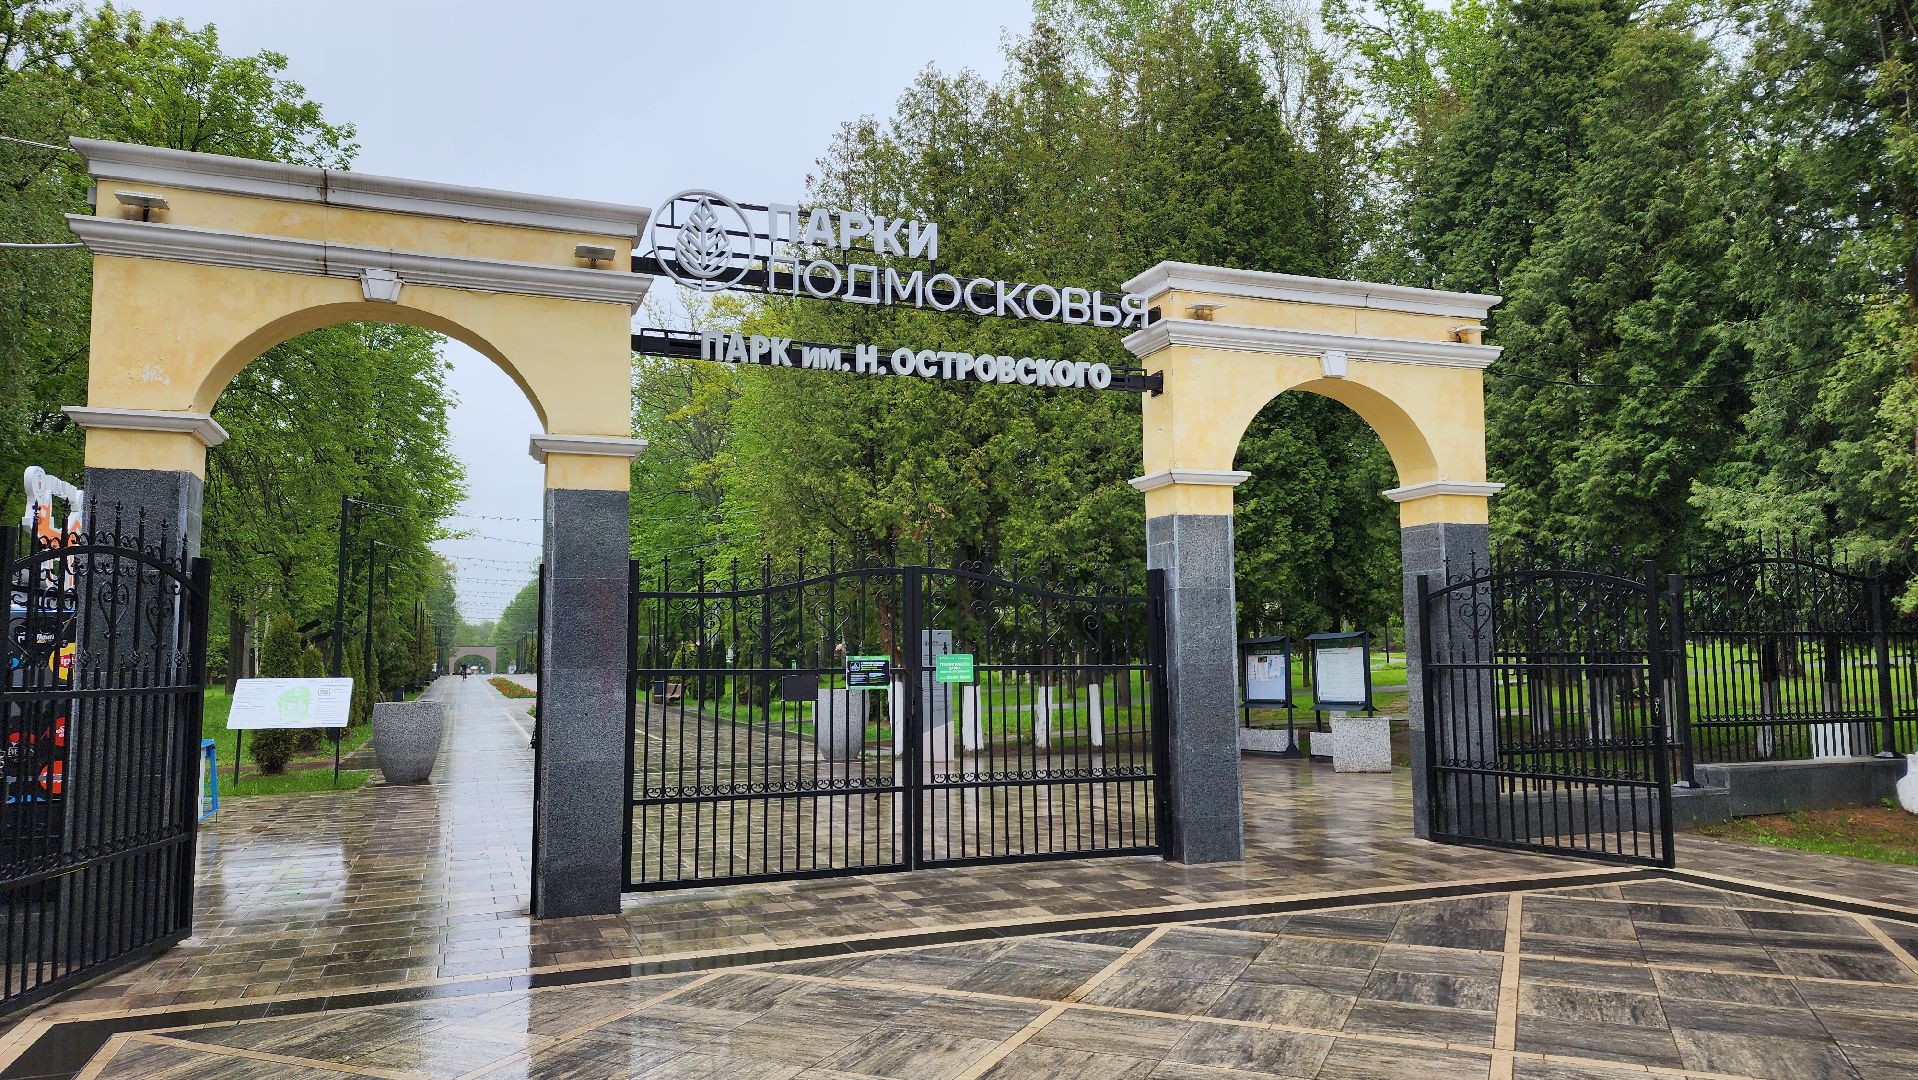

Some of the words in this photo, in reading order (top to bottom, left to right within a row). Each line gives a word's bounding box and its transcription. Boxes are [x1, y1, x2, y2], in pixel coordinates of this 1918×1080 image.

[768, 203, 938, 260] ПАРКИ
[769, 255, 1149, 329] ПОДМОСКОВЬЯ
[702, 331, 793, 367] ПАРК
[855, 343, 887, 375] Н.
[890, 347, 1112, 389] ОСТРОВСКОГО
